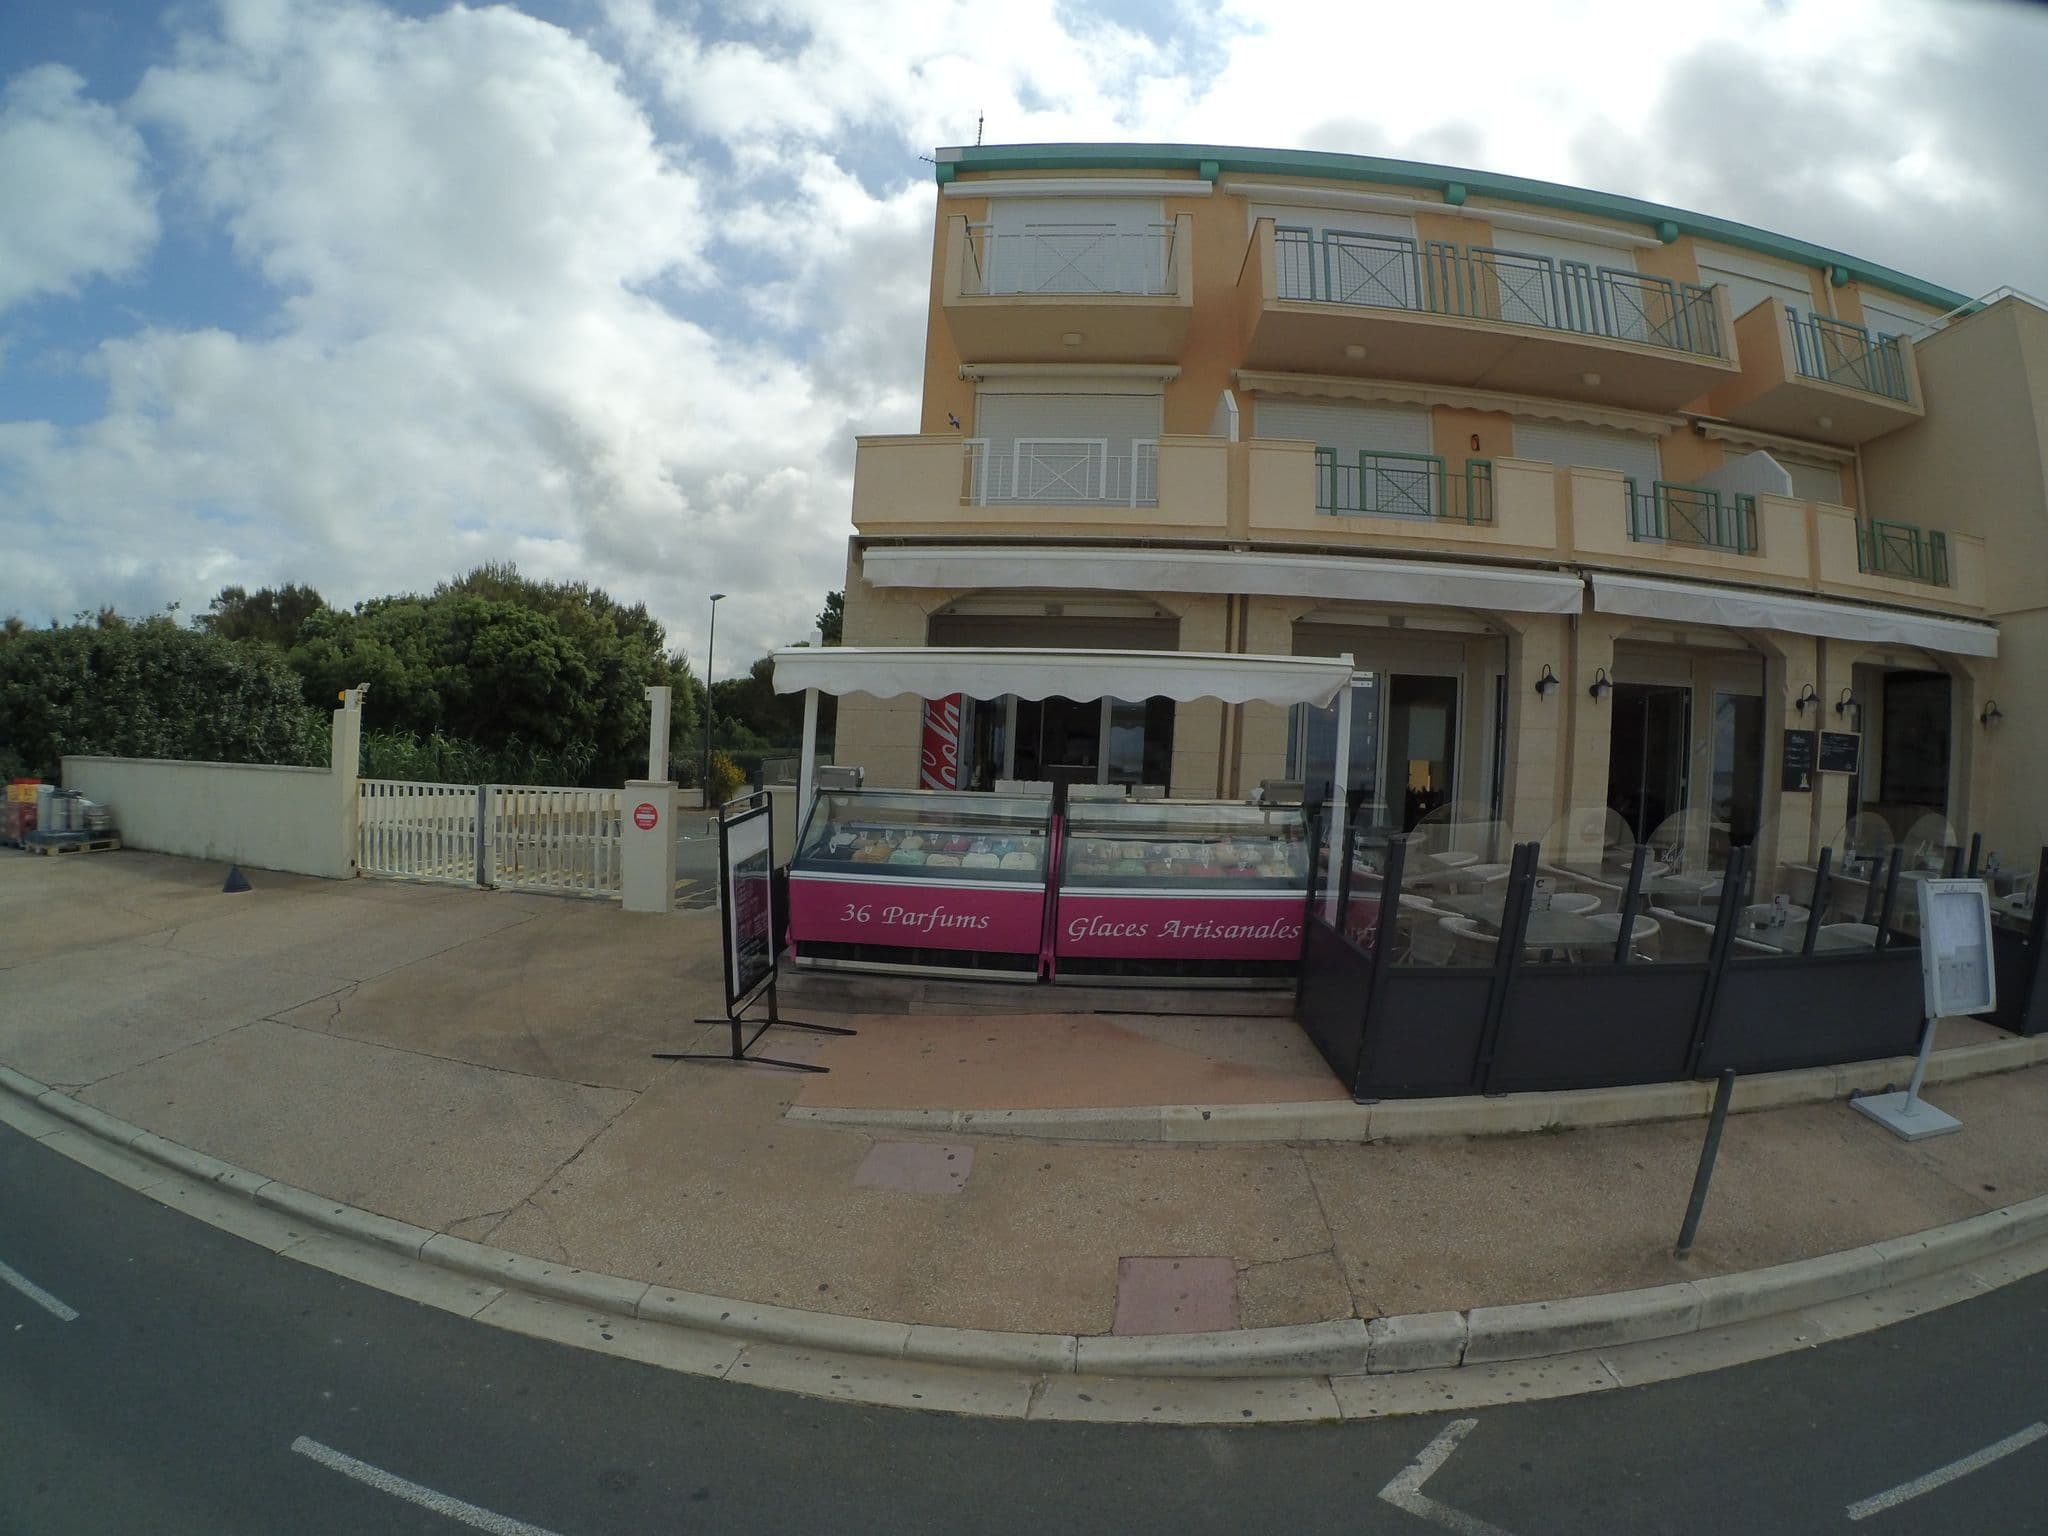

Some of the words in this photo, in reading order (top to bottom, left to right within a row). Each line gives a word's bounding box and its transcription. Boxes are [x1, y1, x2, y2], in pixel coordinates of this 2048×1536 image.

[840, 903, 872, 923] 36
[881, 905, 990, 933] Parfums
[1068, 915, 1149, 942] Glaces
[1157, 917, 1302, 939] Artisanales
